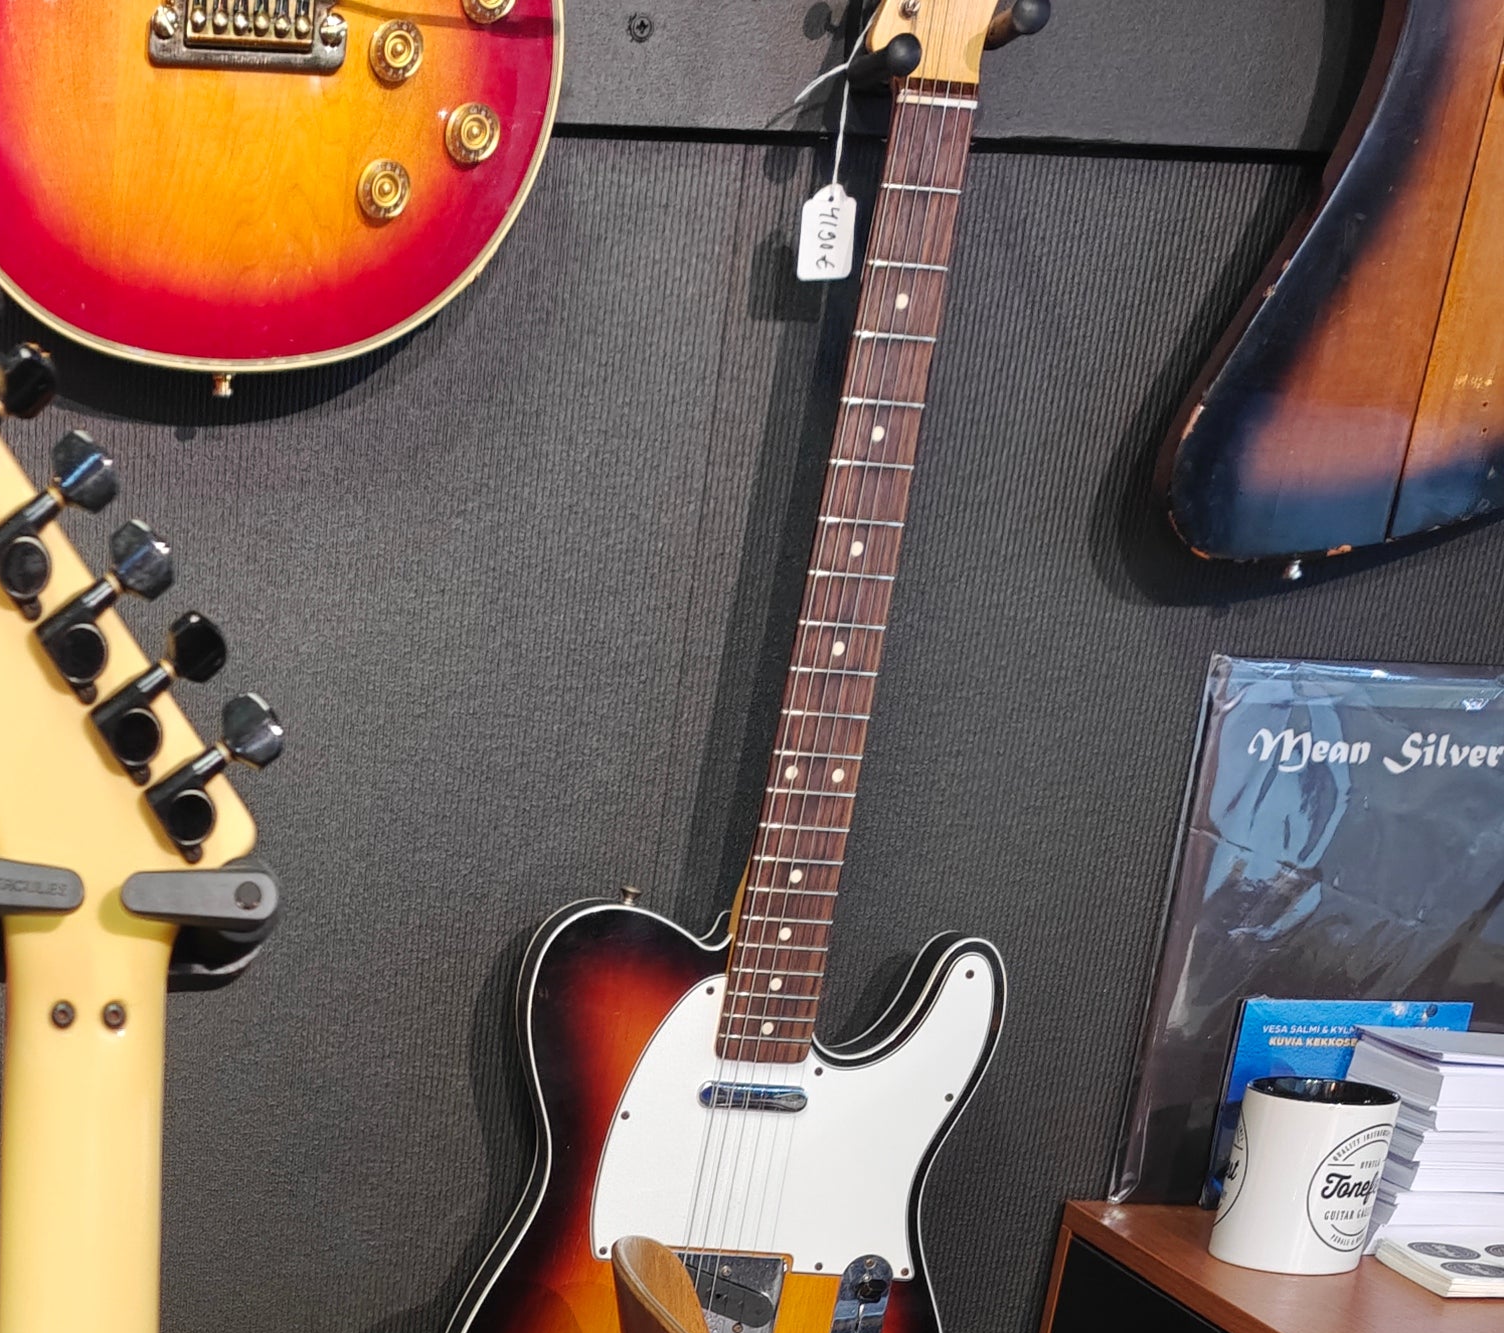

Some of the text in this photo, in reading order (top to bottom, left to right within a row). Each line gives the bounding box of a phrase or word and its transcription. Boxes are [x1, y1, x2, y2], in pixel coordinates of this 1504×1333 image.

[1248, 728, 1504, 775] Mean Silver
[1263, 1025, 1288, 1033] VESA
[1290, 1025, 1320, 1033] SALMI
[1322, 1025, 1329, 1033] &
[1269, 1037, 1303, 1046] KUVIA
[1324, 1210, 1355, 1221] GUITAR
